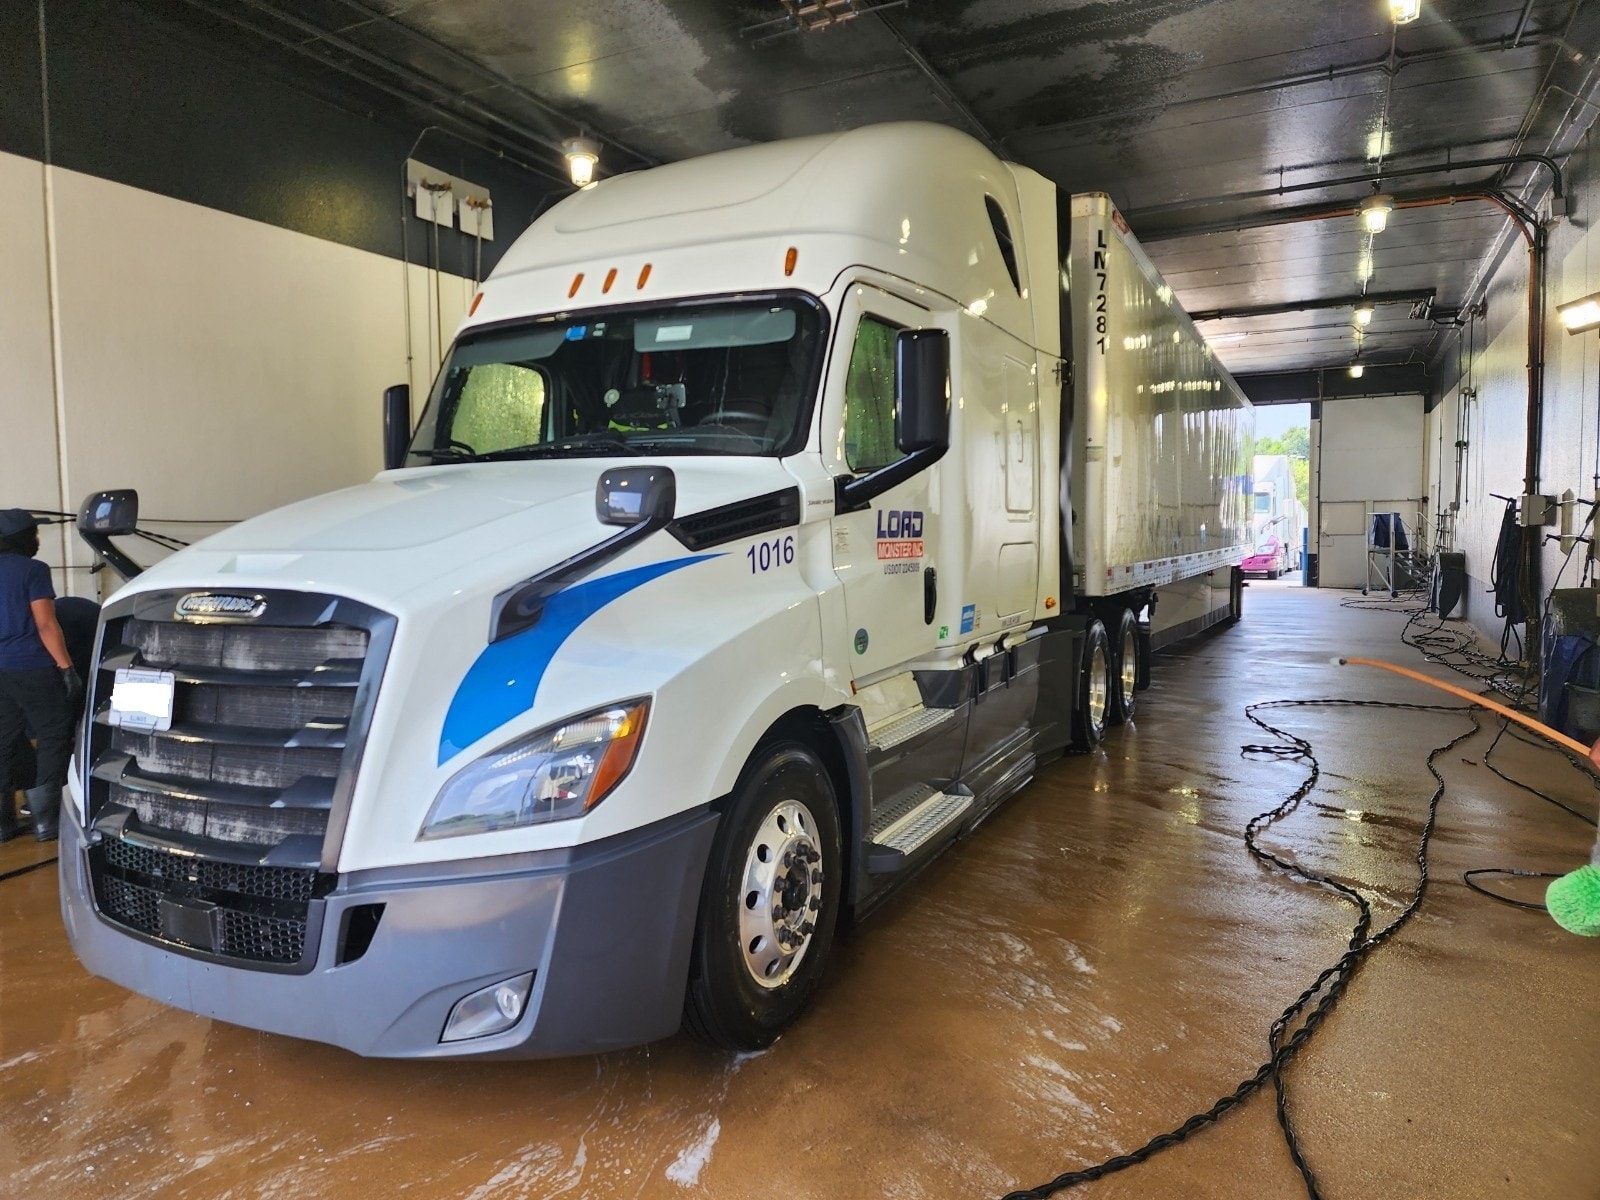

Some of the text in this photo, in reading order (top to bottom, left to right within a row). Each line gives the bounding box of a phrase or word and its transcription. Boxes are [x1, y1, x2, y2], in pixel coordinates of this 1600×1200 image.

[877, 509, 923, 539] LOAD
[747, 535, 794, 575] 1016
[878, 542, 923, 558] MONSTER INC
[884, 563, 901, 575] USDOT
